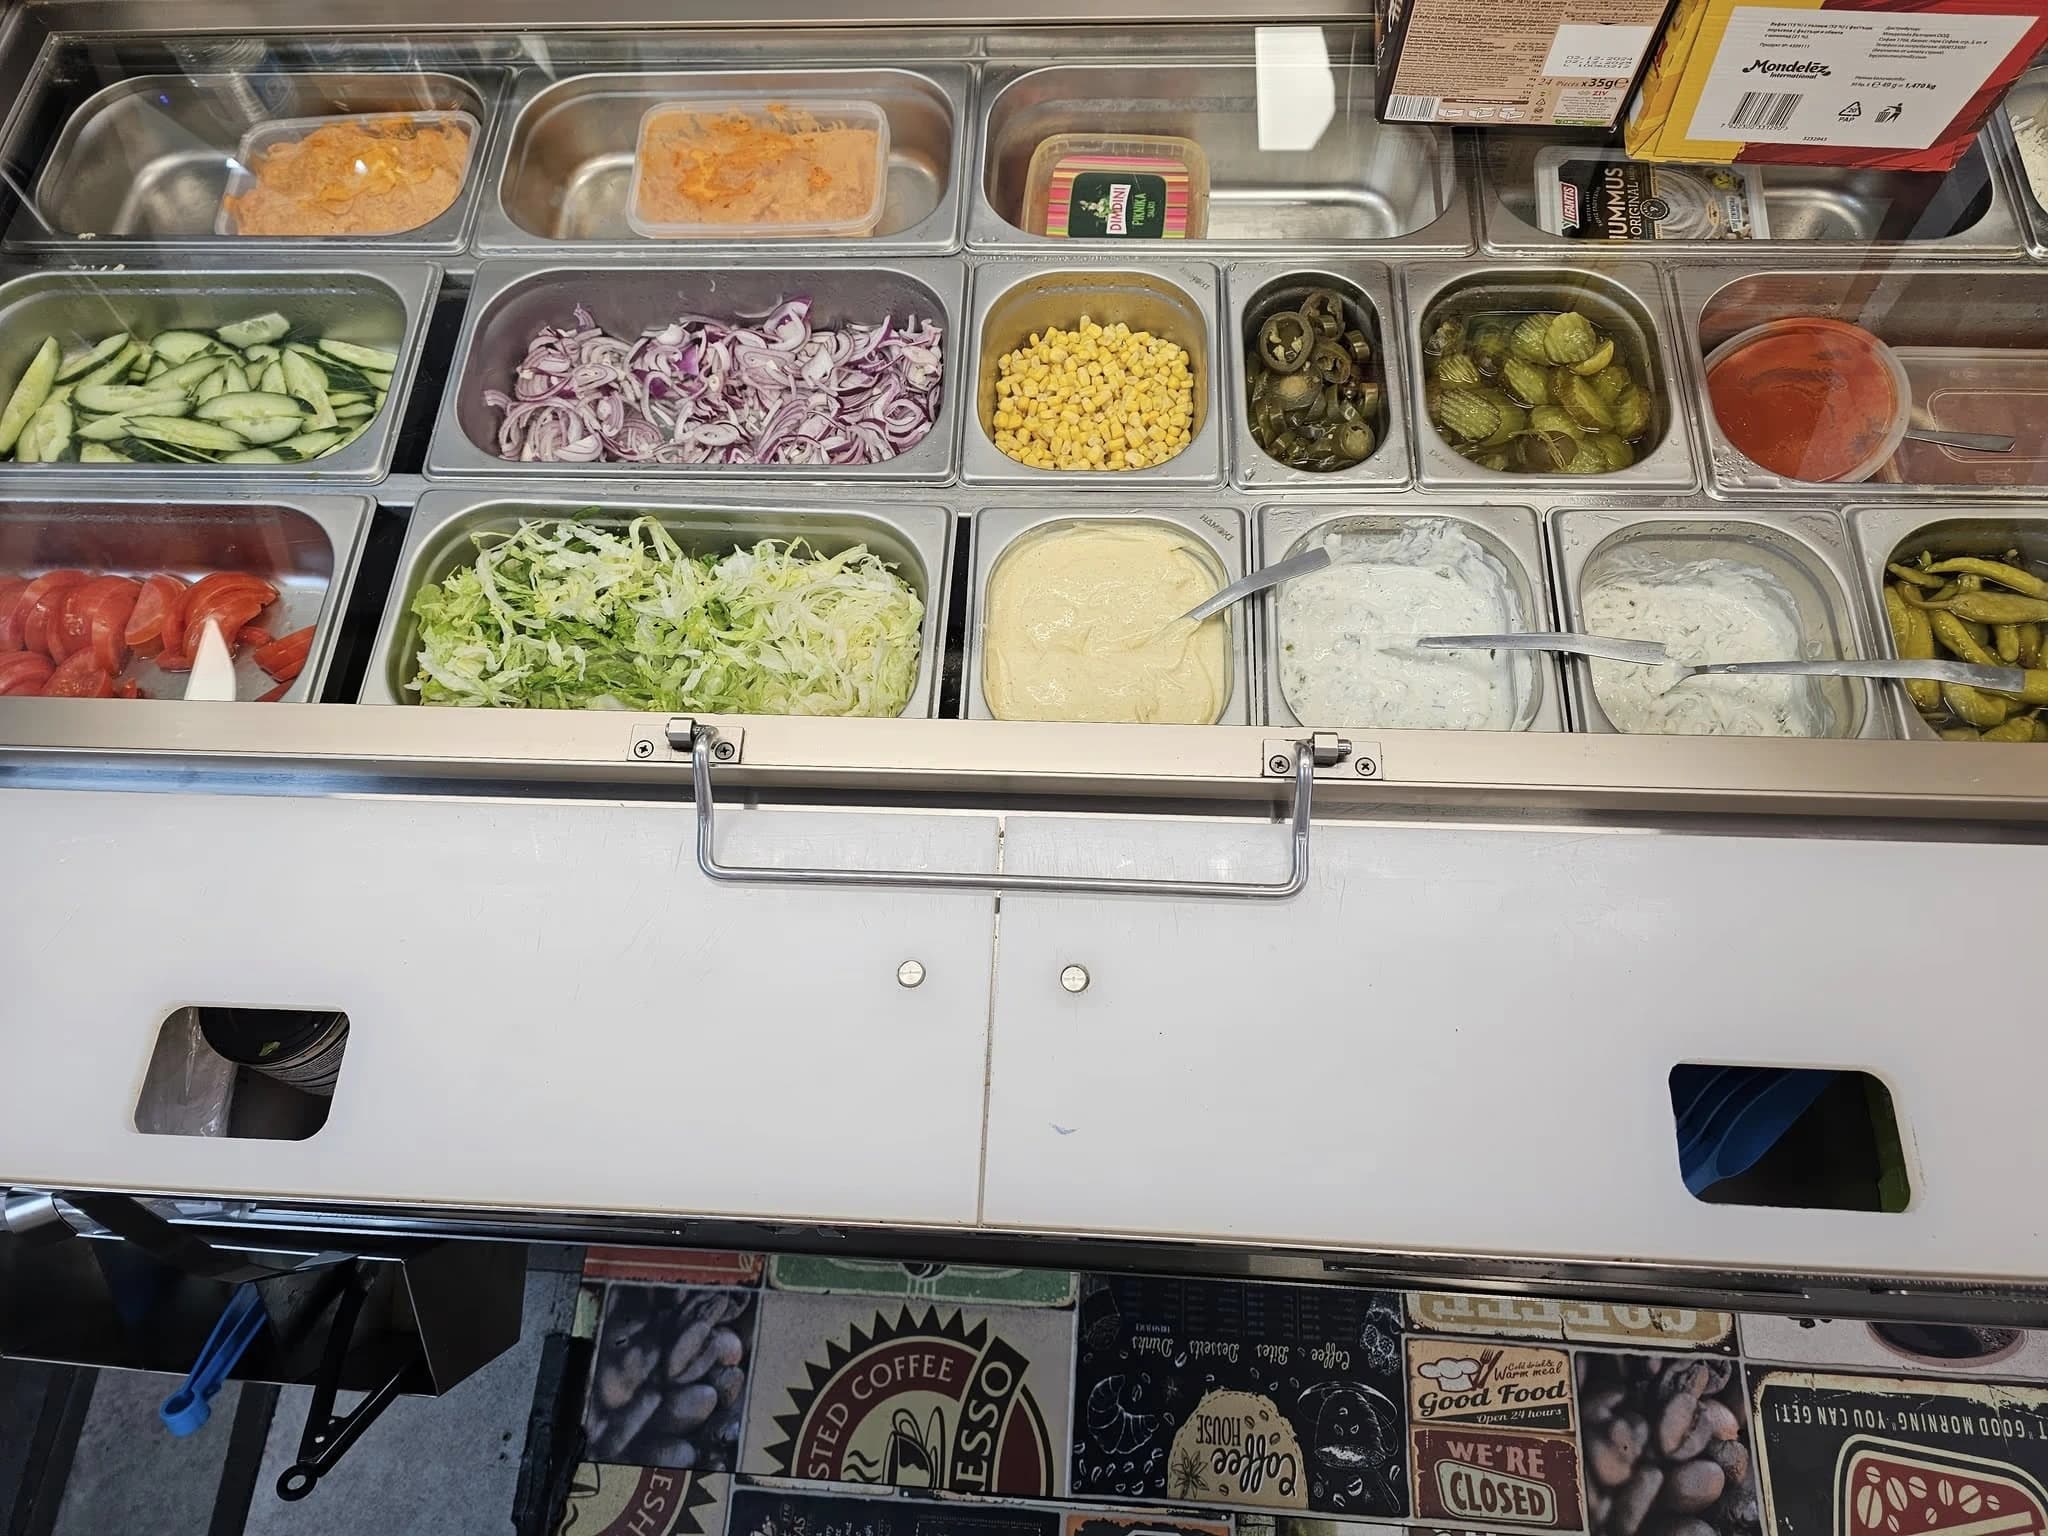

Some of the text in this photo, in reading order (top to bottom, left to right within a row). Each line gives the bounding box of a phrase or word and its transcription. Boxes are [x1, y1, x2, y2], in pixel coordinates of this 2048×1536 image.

[1769, 71, 1818, 80] International
[1131, 192, 1147, 226] PIKNIKA
[1627, 181, 1643, 235] ORIGINAL
[1131, 1335, 1174, 1358] Drinks
[1189, 1340, 1240, 1363] Desserts
[1256, 1343, 1290, 1365] Bites
[1311, 1342, 1351, 1370] Coffee
[851, 1354, 954, 1400] COFFEE
[1494, 1360, 1563, 1382] Warm meal
[1417, 1380, 1568, 1417] Good Food
[956, 1361, 1012, 1491] ESSO
[1476, 1408, 1562, 1425] Open 24 hours
[1774, 1402, 1812, 1425] GET!
[1818, 1405, 1848, 1427] CAN
[1853, 1409, 1887, 1430] YOU
[1196, 1414, 1297, 1497] Coffee HOUSE
[1447, 1440, 1546, 1479] WE'RE
[1450, 1470, 1547, 1516] CLOSED
